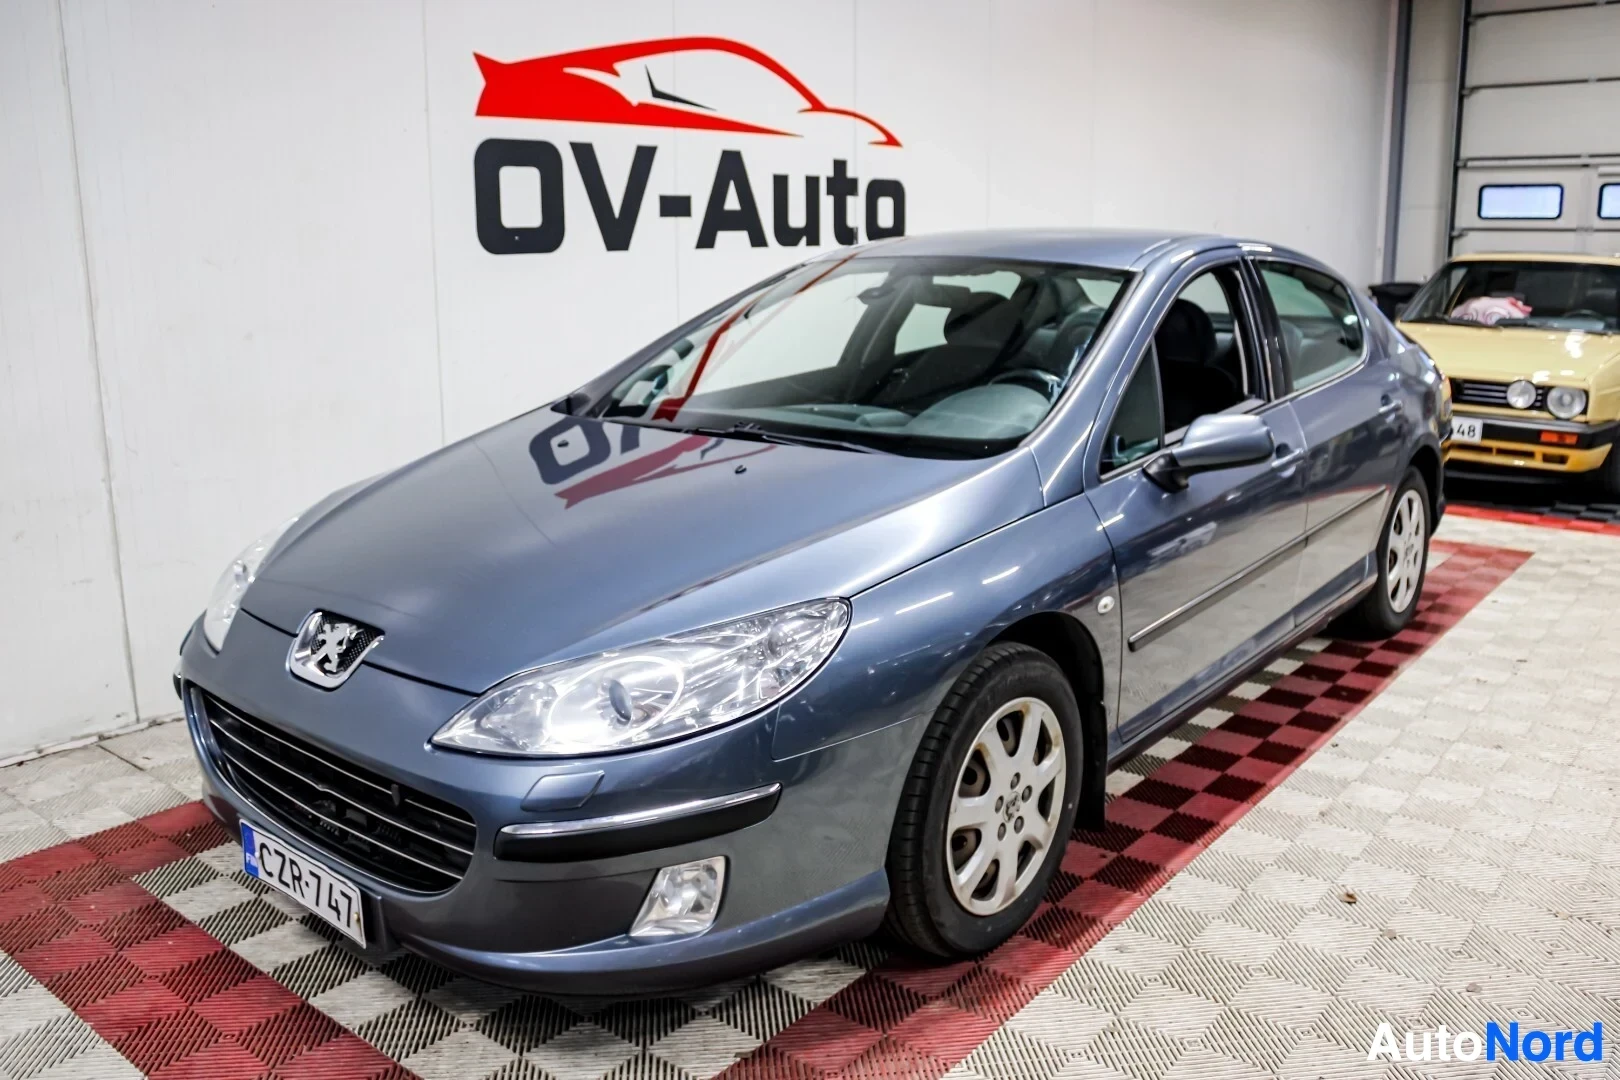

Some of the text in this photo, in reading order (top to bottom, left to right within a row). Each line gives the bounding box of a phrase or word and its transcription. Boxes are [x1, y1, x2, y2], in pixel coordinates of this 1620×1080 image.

[474, 138, 906, 255] OV-Auto
[1449, 423, 1476, 438] 48
[259, 842, 352, 928] CZR-747
